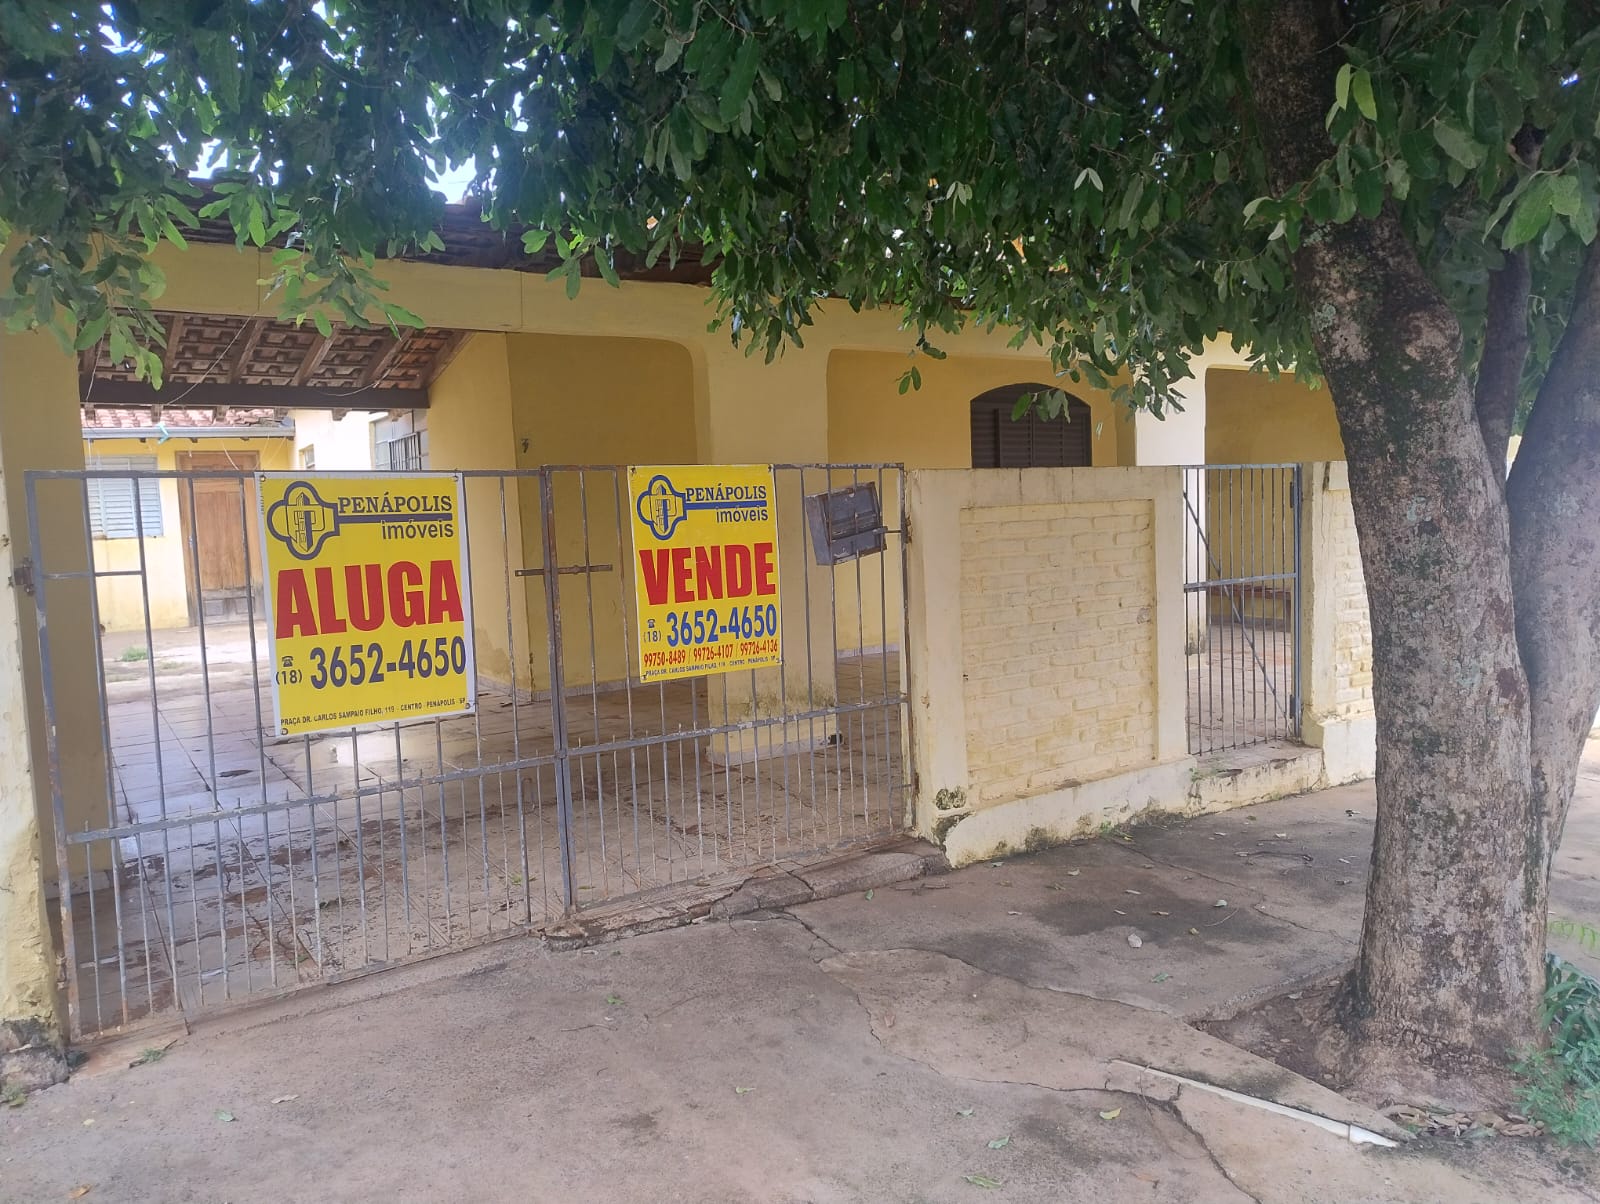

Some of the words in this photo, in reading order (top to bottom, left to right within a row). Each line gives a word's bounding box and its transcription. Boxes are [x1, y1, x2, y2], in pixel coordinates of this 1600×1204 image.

[338, 492, 452, 513] PENÁPOLIS
[685, 483, 767, 502] PENÁPOLIS
[716, 505, 769, 523] imóveis
[382, 519, 454, 539] imóveis
[639, 542, 776, 605] VENDE
[276, 560, 464, 639] ALUGA
[643, 630, 661, 642] (18)
[666, 604, 777, 647] 3652-4650
[276, 669, 302, 685] (18)
[310, 636, 466, 689] 3652-4650
[643, 649, 686, 667] 99750-8489
[693, 643, 733, 661] 99726-4107
[740, 639, 778, 656] 99726-4136
[280, 718, 301, 726] PRAÇA
[313, 712, 337, 722] CARLOS
[338, 709, 364, 719] SAMPAIO
[400, 702, 422, 711] CENTRO
